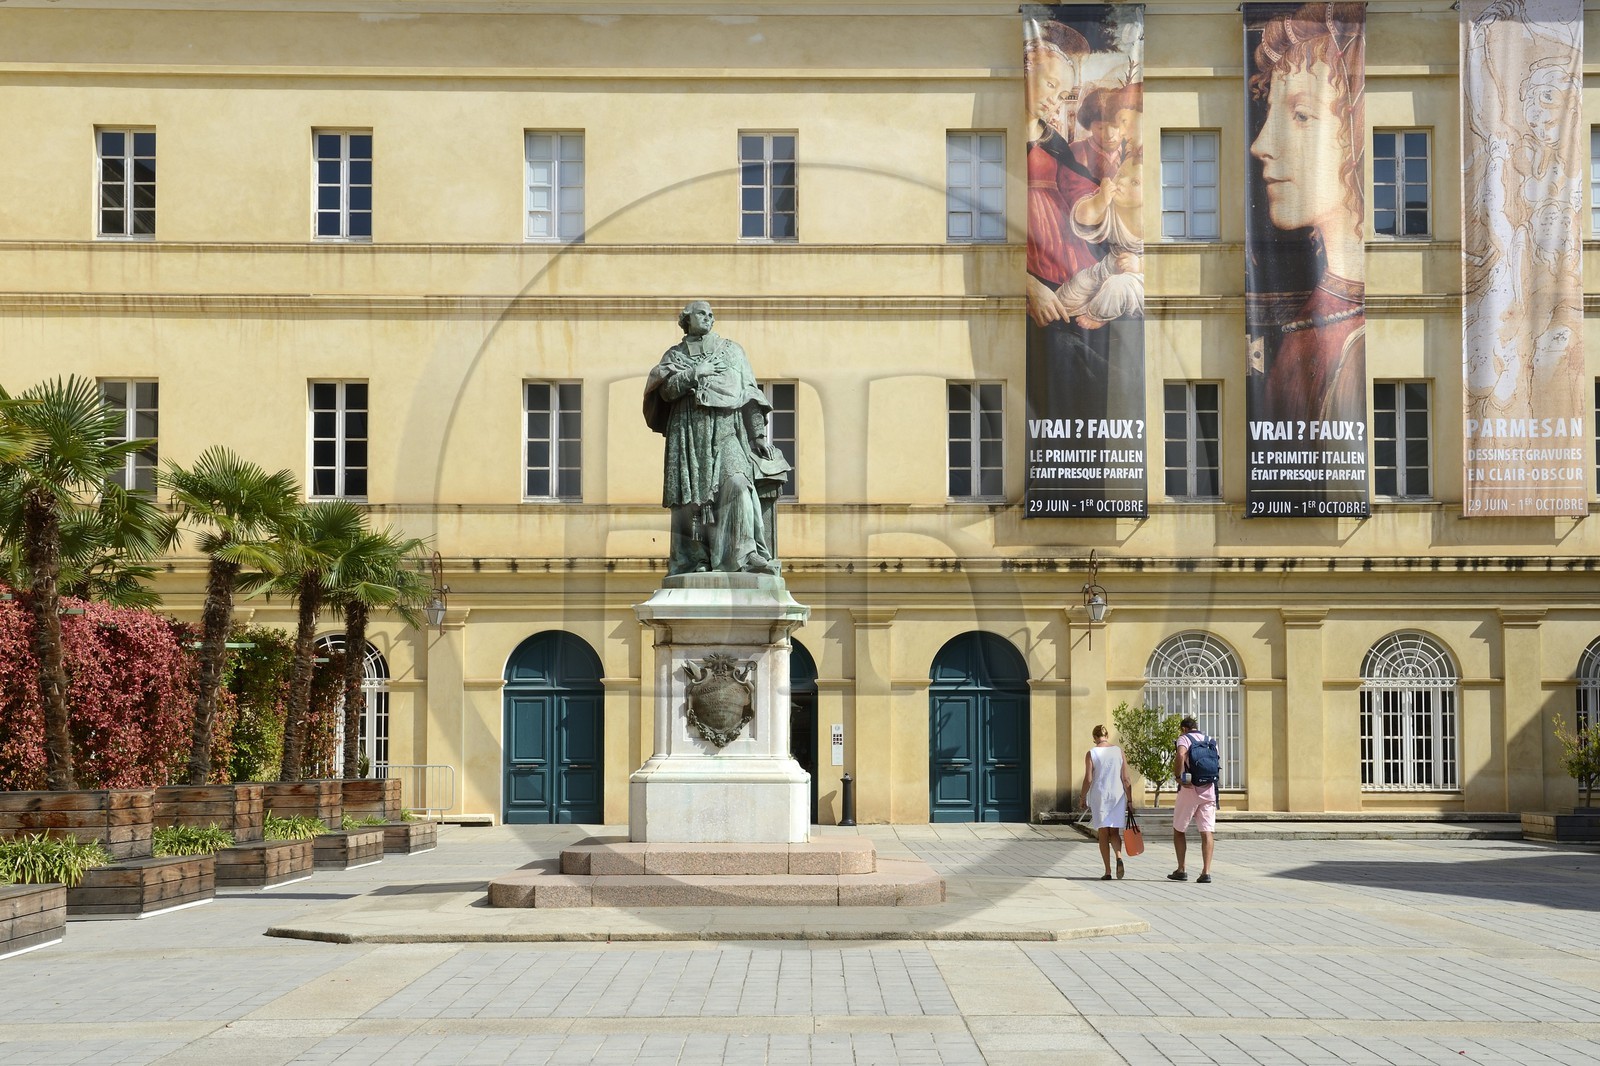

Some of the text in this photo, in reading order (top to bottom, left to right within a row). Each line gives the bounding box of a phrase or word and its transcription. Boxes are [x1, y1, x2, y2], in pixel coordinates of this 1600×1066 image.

[1466, 418, 1583, 438] PARMESAN
[1030, 450, 1143, 462] LE PRIMITIF ITALIEN
[1251, 452, 1365, 464] LE PRIMITIF ITALIEN
[1468, 448, 1582, 461] DESSINS ET GRAVURES
[1030, 466, 1144, 480] ÉTAIT PRESQUE PARFAIT
[1251, 468, 1366, 481] ÉTAIT PRESQUE PARFAIT
[1468, 467, 1583, 481] EN CLAIR-OBSCUR
[1030, 500, 1043, 512] 29
[1046, 500, 1069, 512] JUIN
[1096, 500, 1144, 512] OCTOBRE
[1251, 501, 1265, 514] 29
[1267, 501, 1291, 514] JUIN
[1318, 501, 1366, 514] OCTOBRE
[1468, 499, 1481, 511] 29
[1485, 499, 1508, 511] JUIN
[1535, 498, 1584, 511] OCTOBRE
